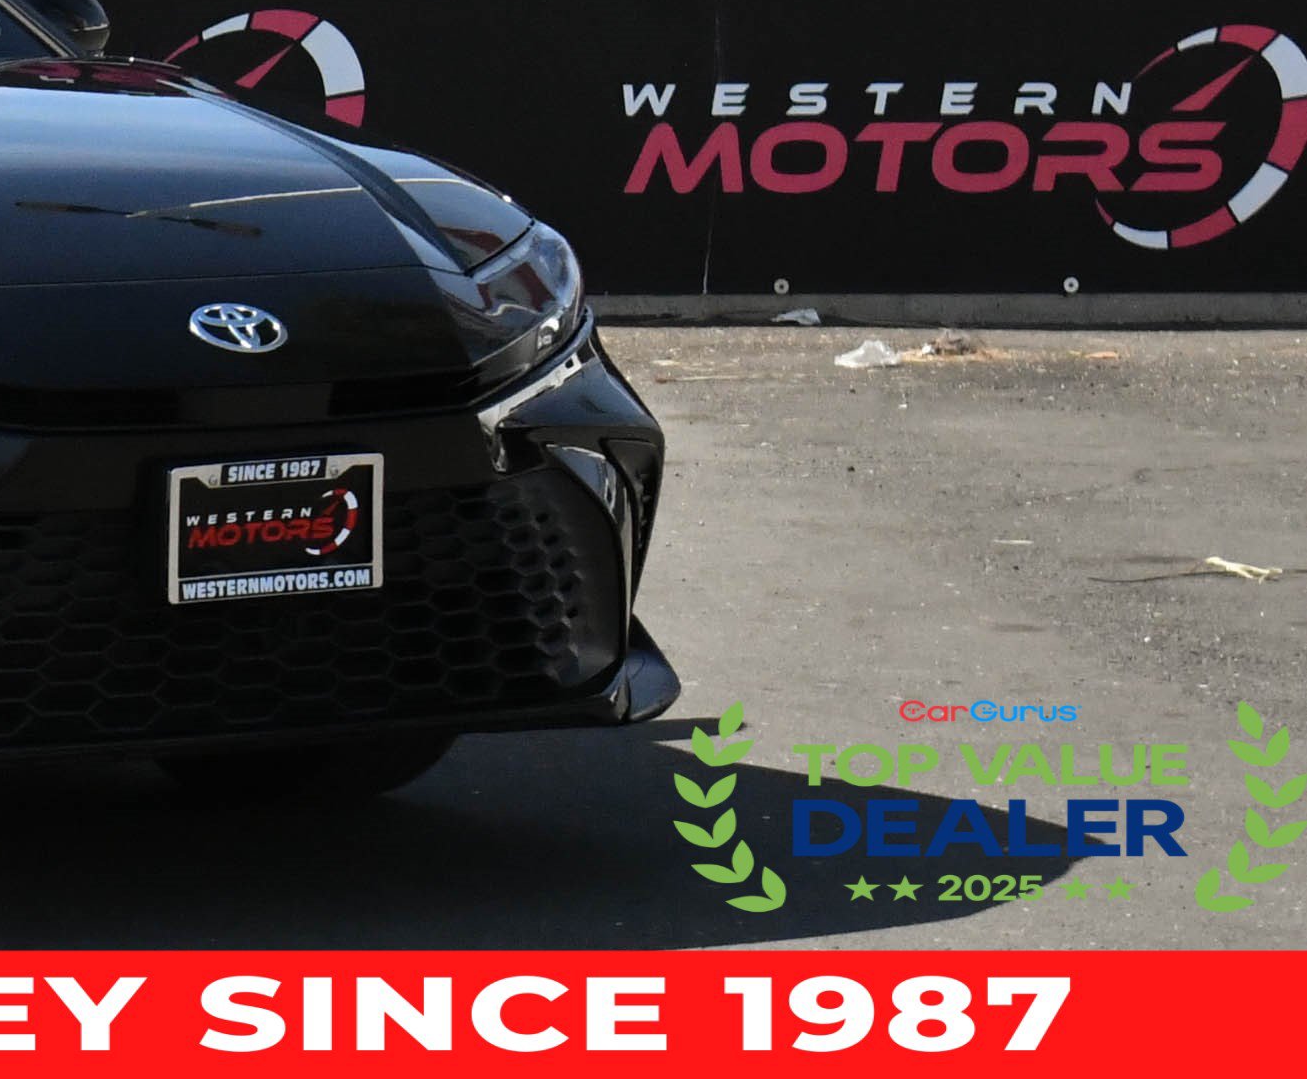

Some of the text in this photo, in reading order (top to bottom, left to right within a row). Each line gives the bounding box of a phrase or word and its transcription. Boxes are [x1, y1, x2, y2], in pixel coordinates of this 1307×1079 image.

[623, 83, 1131, 116] WESTERN
[626, 122, 1224, 193] MOTORS
[228, 460, 320, 482] SINCE 1987
[186, 507, 312, 527] WESTERN
[188, 517, 334, 549] MOTORS
[182, 569, 371, 600] WESTERNMOTORS.COM
